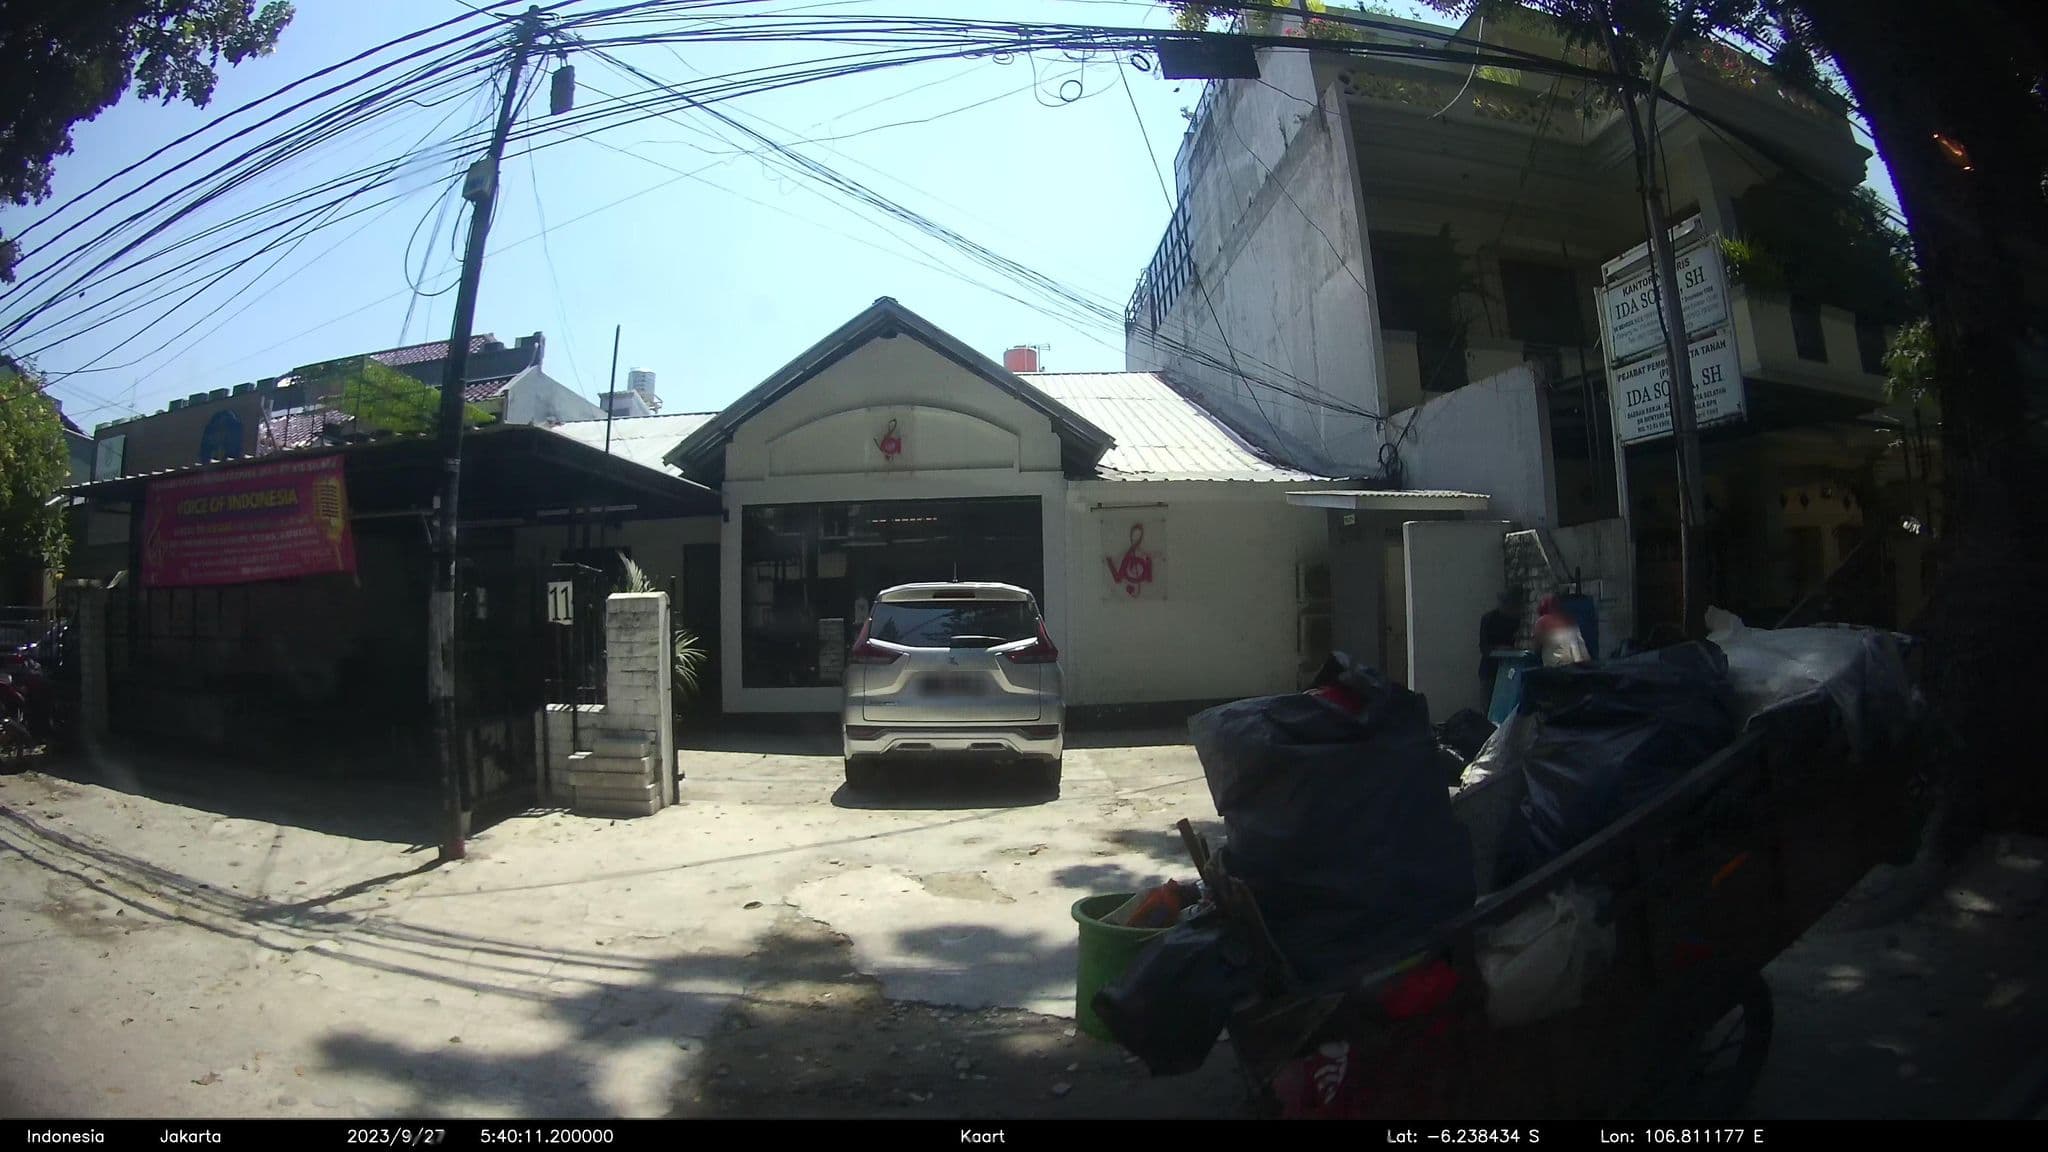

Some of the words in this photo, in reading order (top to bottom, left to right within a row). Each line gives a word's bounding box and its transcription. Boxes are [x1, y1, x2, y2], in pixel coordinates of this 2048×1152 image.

[1615, 298, 1640, 320] IDA
[1685, 266, 1705, 289] SH
[1626, 385, 1651, 408] IDA
[1702, 364, 1724, 386] SH
[209, 495, 224, 513] OF
[227, 488, 298, 511] INDONESIA
[549, 586, 572, 621] 11
